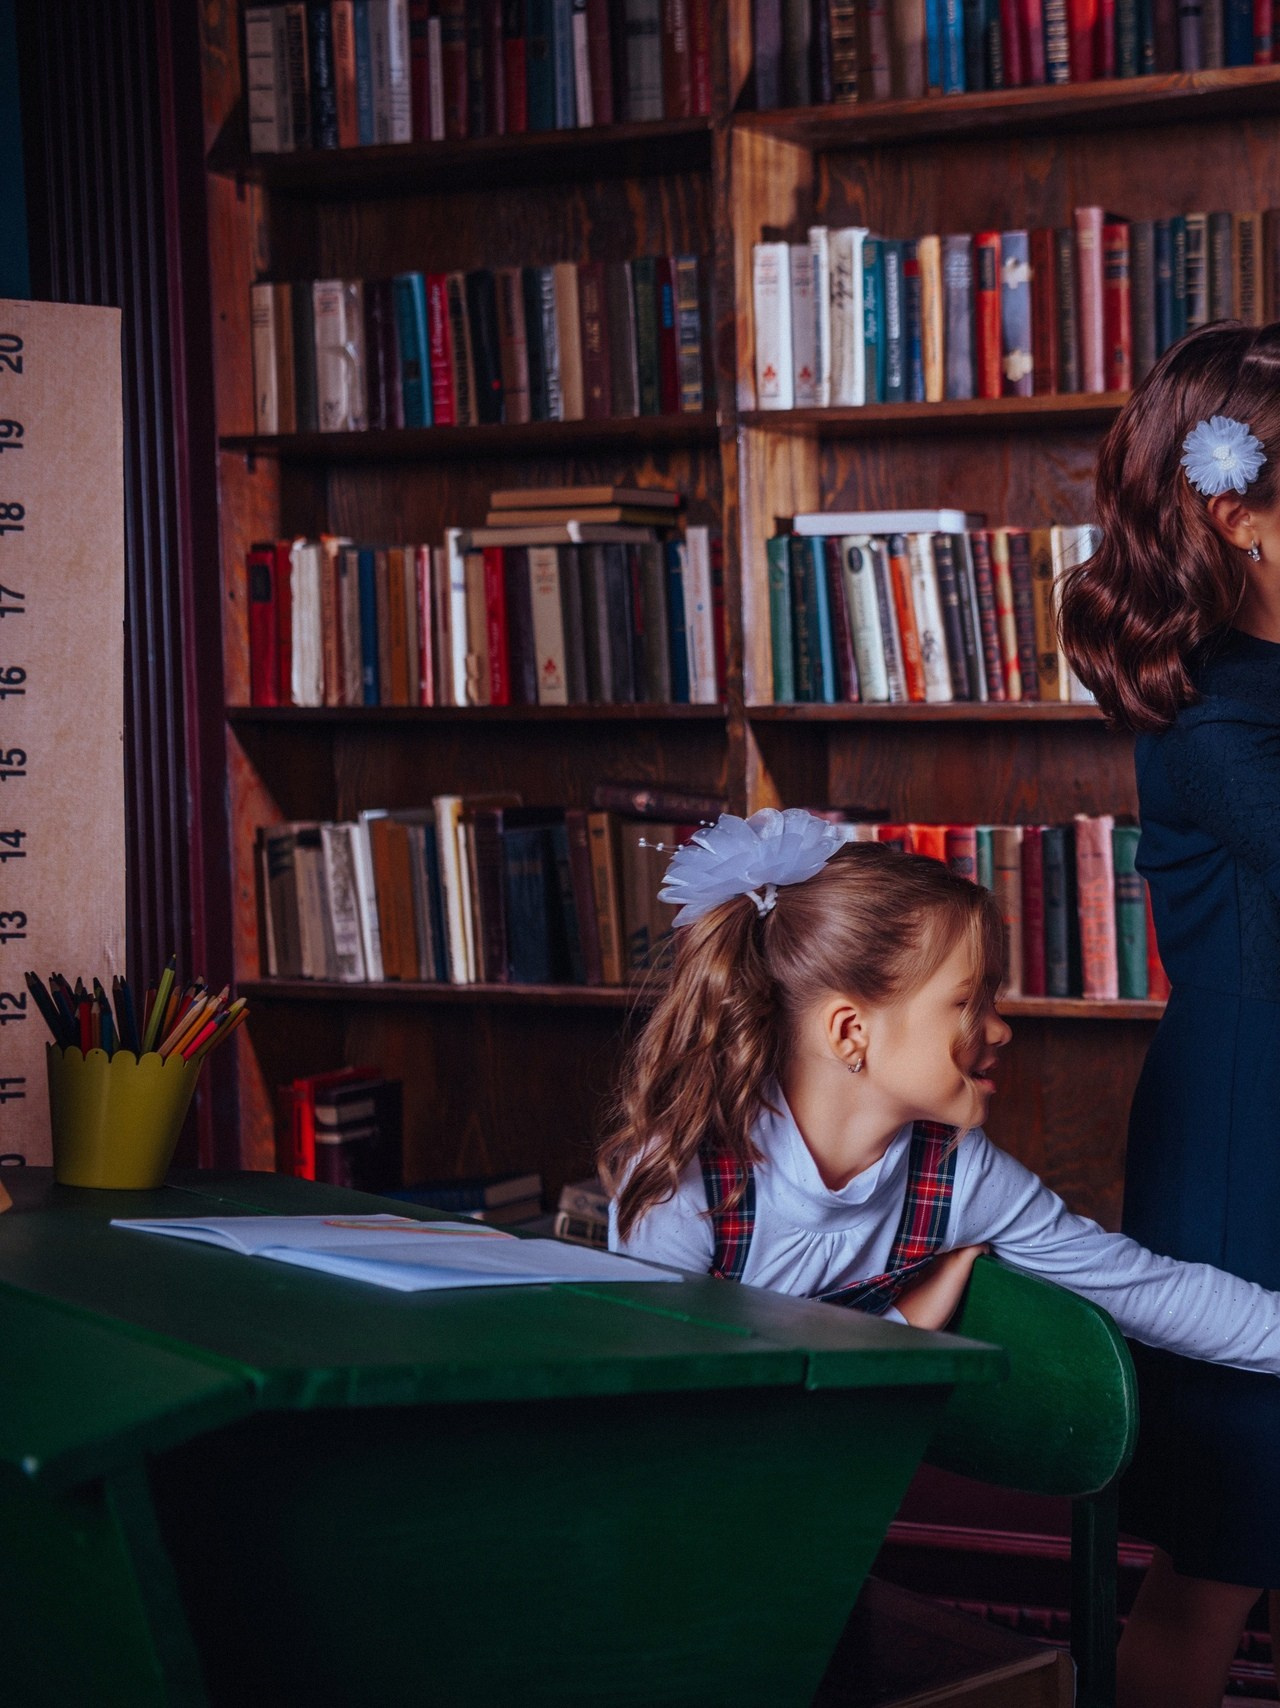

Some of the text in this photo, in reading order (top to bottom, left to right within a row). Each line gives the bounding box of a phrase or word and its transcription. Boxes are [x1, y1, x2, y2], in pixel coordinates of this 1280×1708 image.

[0, 332, 24, 375] 20
[0, 502, 26, 537] 18
[0, 583, 26, 619] 17
[0, 666, 27, 701] 16
[0, 748, 27, 782] 15
[0, 828, 27, 864] 14
[0, 910, 28, 945] 13
[0, 991, 28, 1027] 12
